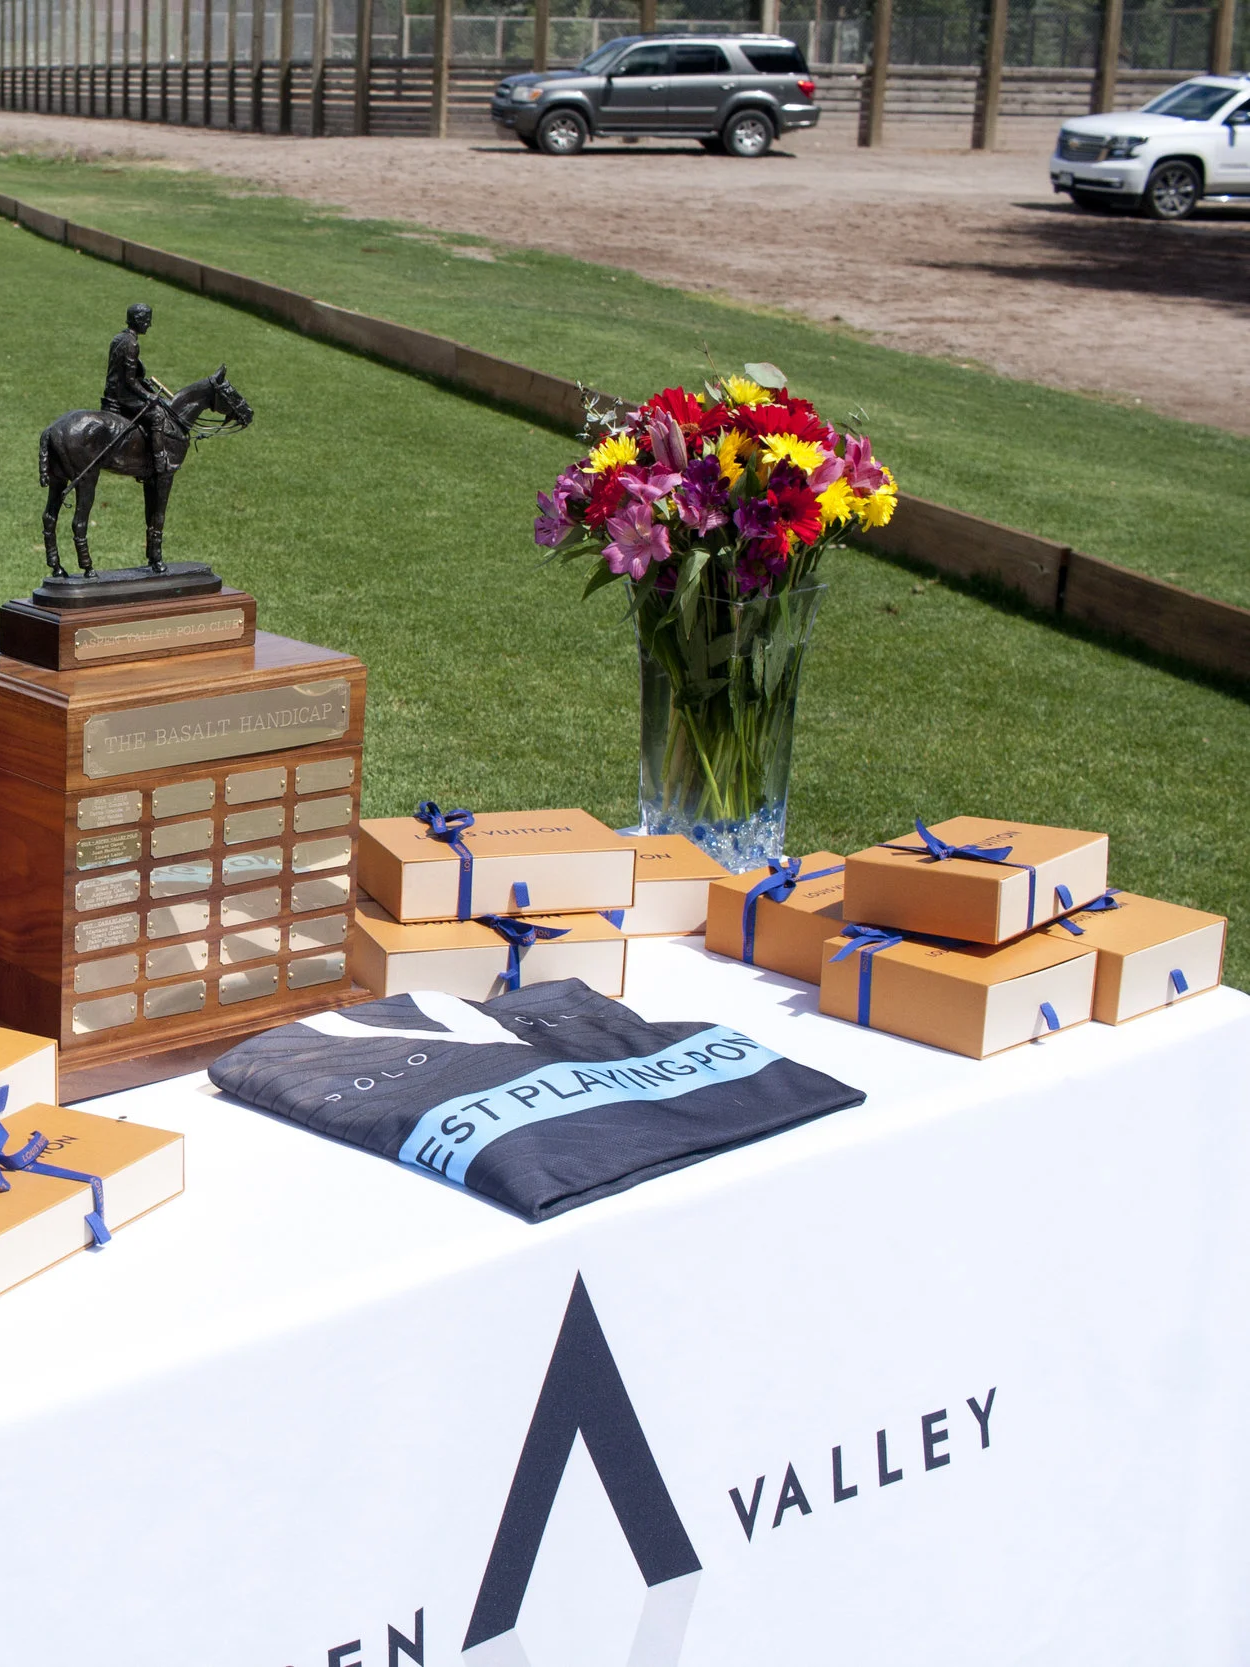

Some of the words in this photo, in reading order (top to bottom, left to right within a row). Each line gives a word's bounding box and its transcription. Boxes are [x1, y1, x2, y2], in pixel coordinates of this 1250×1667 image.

[176, 623, 206, 637] POLO
[209, 619, 239, 633] CLUB
[104, 731, 146, 754] THE
[155, 719, 231, 747] BASALT
[238, 702, 333, 734] HANDICAP
[481, 826, 572, 836] VUITTON
[505, 1060, 697, 1109] PLAYING
[728, 1386, 997, 1543] VALLEY
